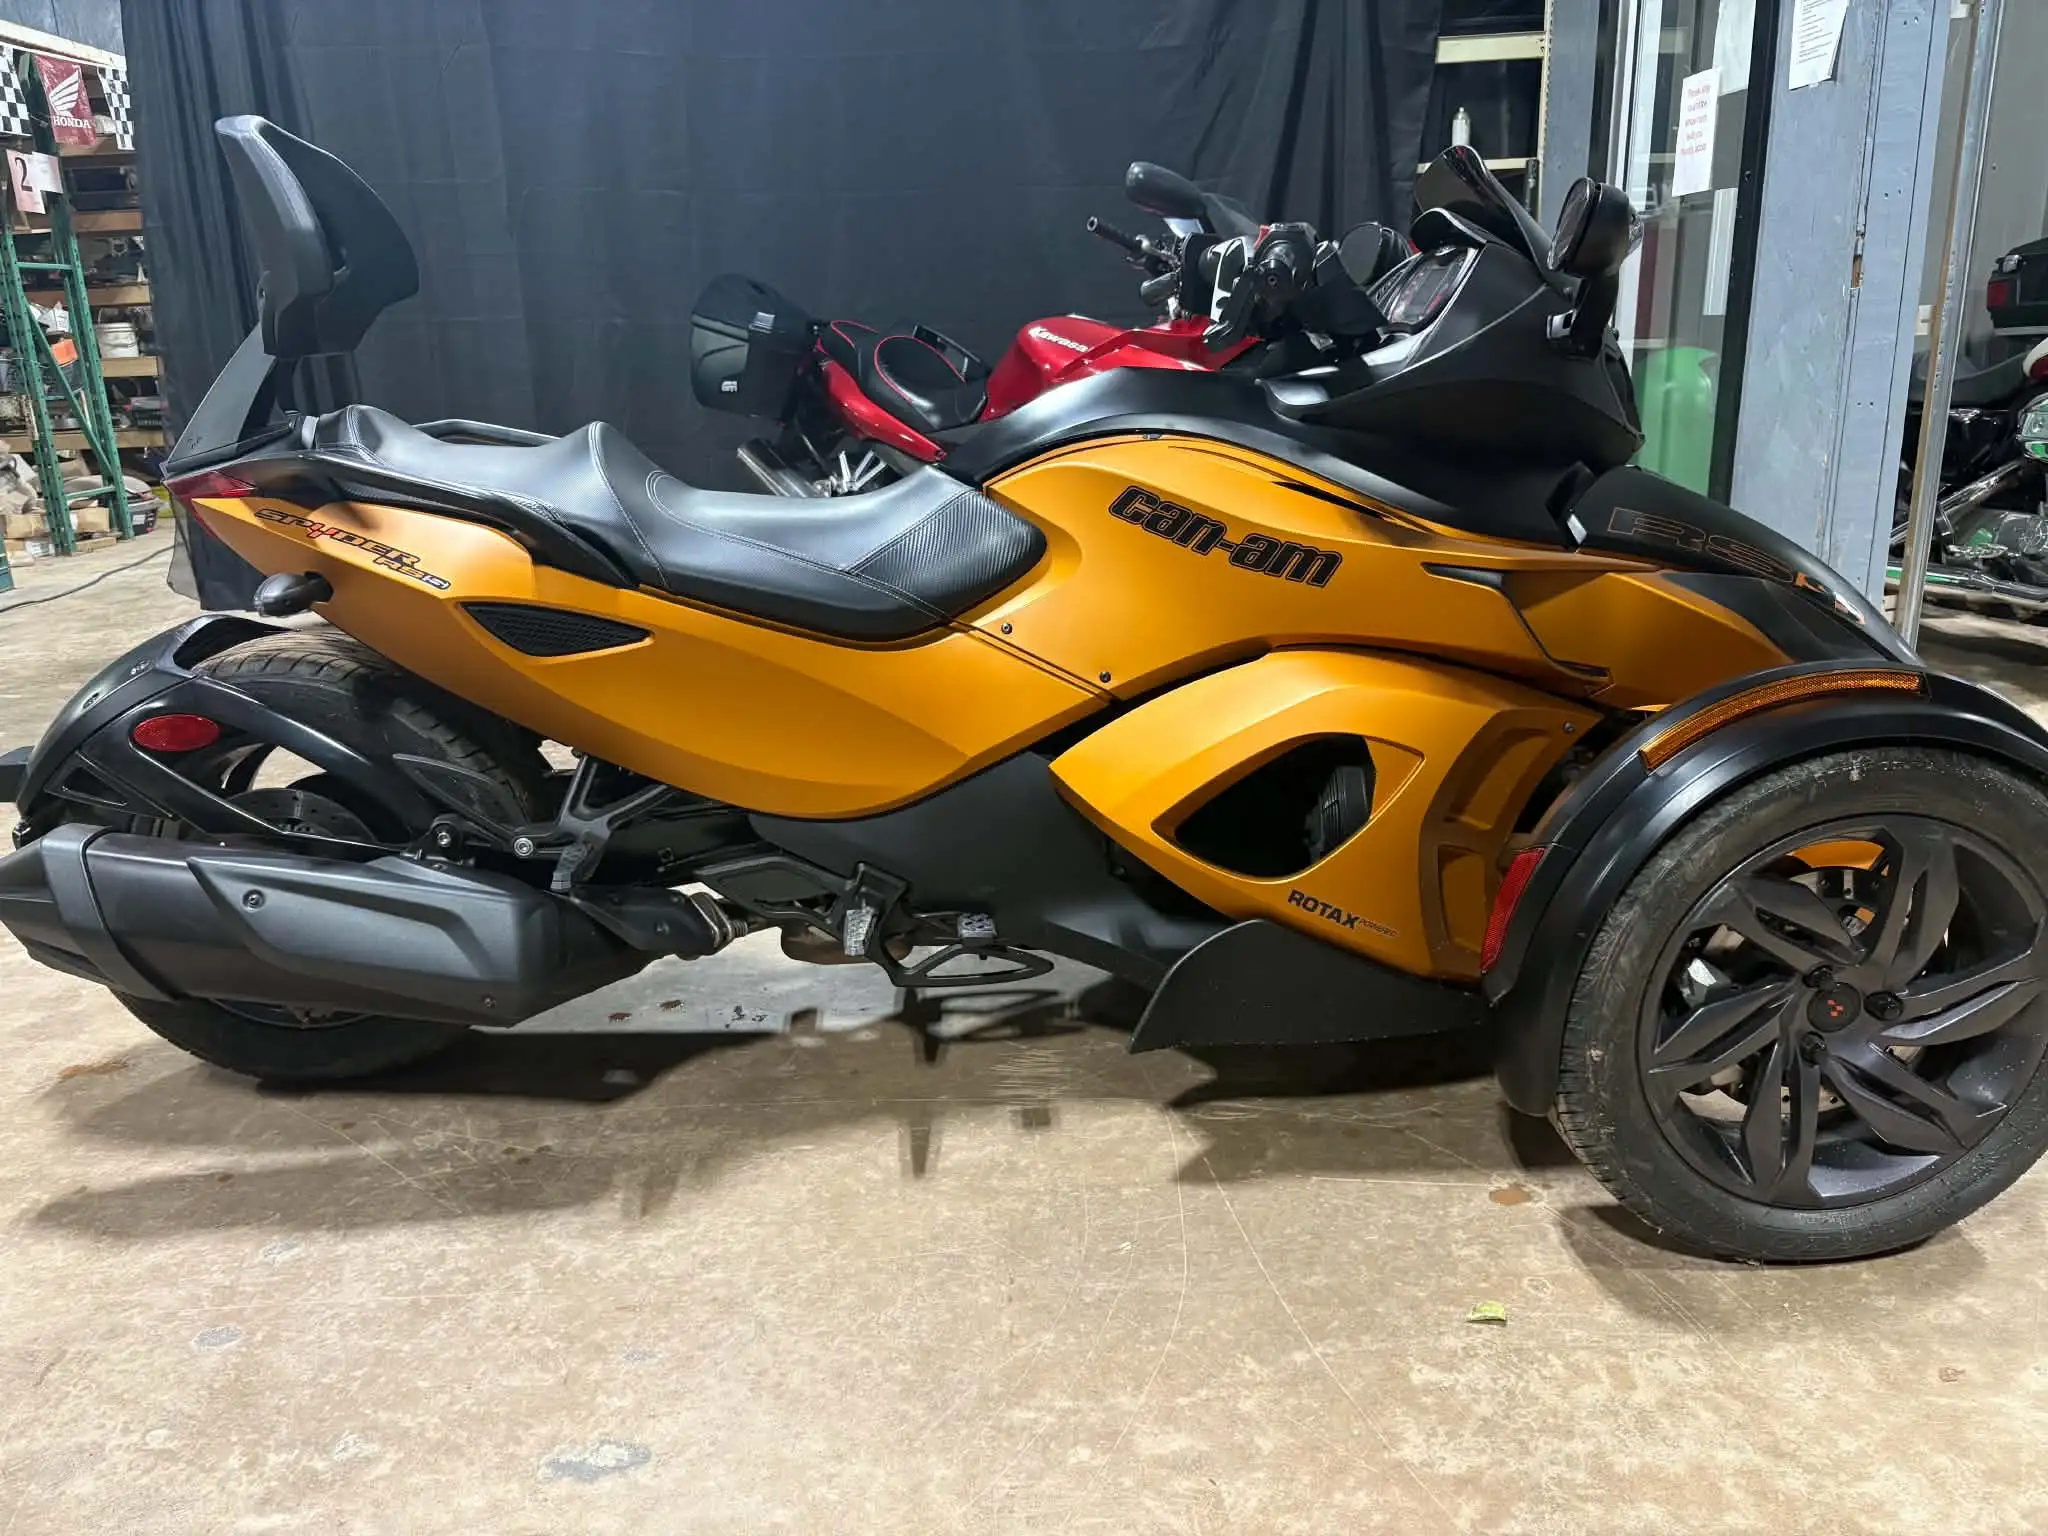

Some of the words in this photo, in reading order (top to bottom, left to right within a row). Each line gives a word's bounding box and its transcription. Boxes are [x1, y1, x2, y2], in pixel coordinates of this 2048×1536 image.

[53, 115, 92, 129] HONDA
[14, 156, 34, 192] 2
[254, 508, 422, 567] SPYDER
[1287, 888, 1361, 930] ROTAX
